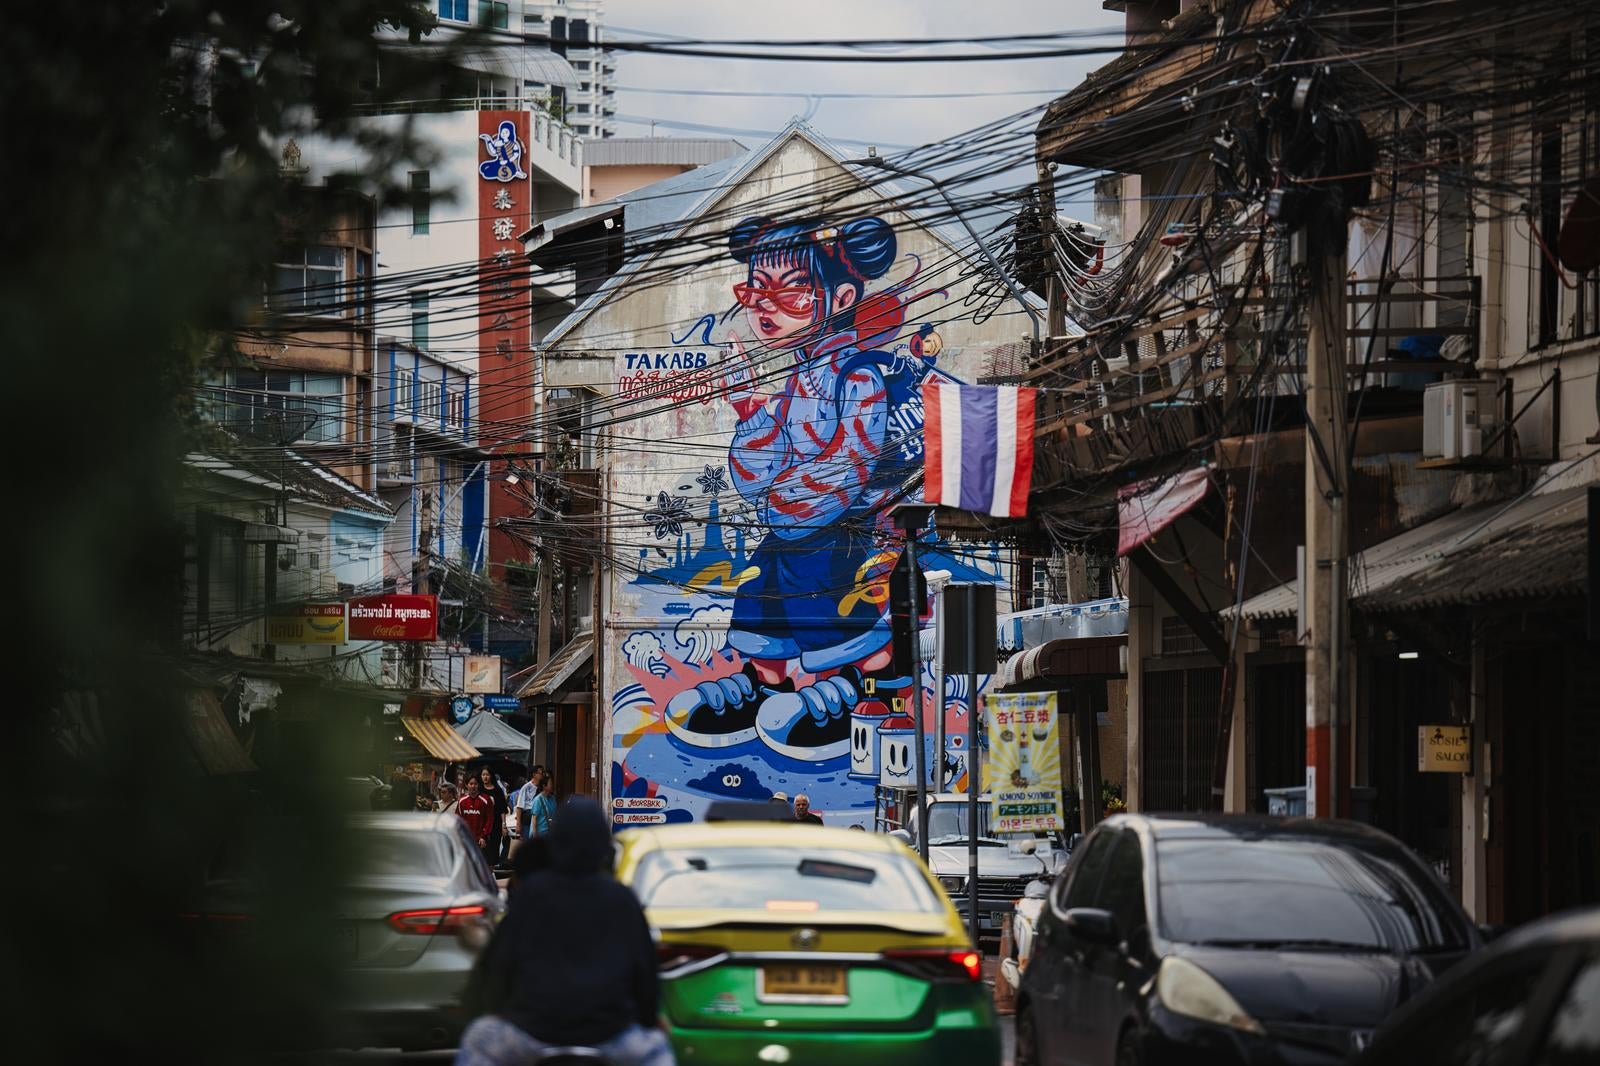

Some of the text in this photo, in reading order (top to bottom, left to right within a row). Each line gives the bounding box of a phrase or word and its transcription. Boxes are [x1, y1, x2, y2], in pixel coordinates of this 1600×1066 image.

[625, 352, 707, 370] TAKABB
[999, 791, 1055, 801] ALMOND SOYMILK
[1001, 804, 1055, 815] アーモンド豆乳
[1000, 816, 1056, 830] 아몬드 두유
